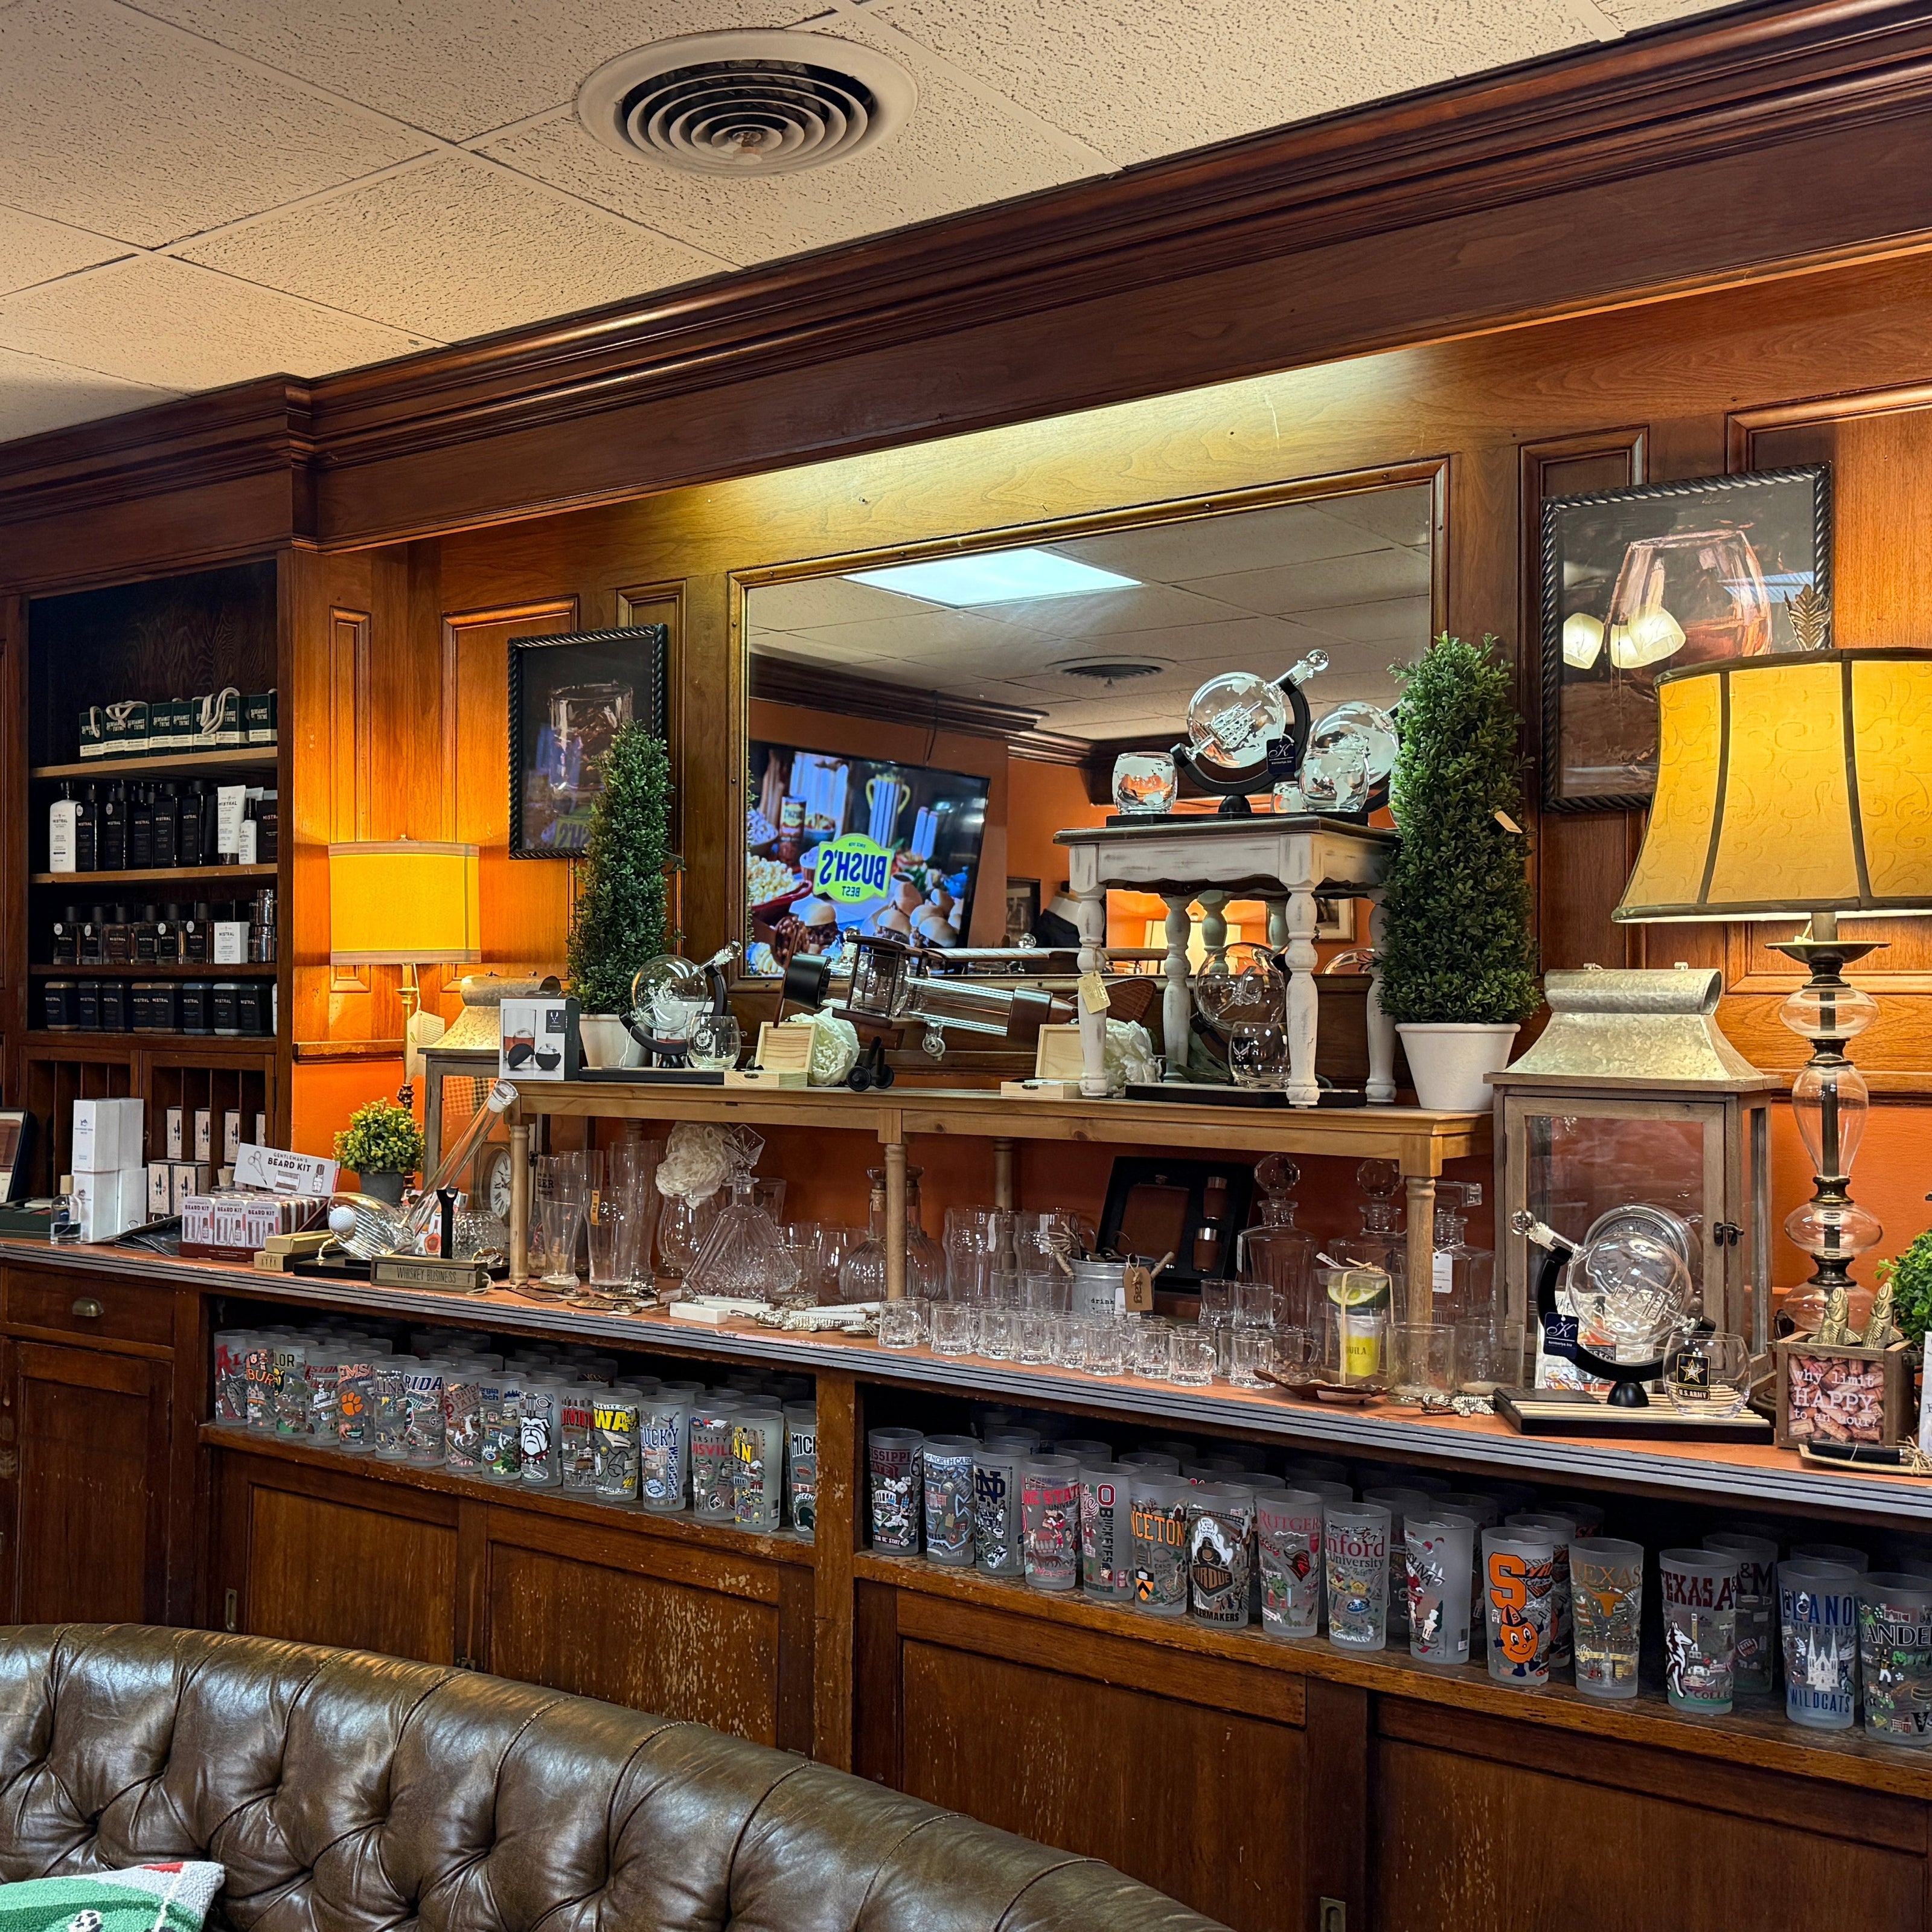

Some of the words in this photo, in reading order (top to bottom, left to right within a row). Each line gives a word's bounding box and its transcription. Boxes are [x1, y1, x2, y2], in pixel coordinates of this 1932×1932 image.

[267, 1157, 295, 1169] BEARD
[297, 1163, 312, 1172] KIT
[273, 1153, 308, 1163] GENTLEMAN'S
[397, 1267, 423, 1281] WHISKEY
[427, 1268, 456, 1284] BUSINESS
[1546, 1322, 1577, 1337] K
[1794, 1369, 1823, 1385] why
[1831, 1372, 1875, 1387] limit
[1794, 1387, 1875, 1413] HAPPY
[1794, 1409, 1808, 1419] to
[1814, 1413, 1831, 1422] an
[1839, 1413, 1878, 1429] hour?
[932, 1454, 953, 1465] NORTH
[1329, 1553, 1384, 1570] University
[1488, 1552, 1527, 1610] S
[1791, 1689, 1850, 1713] WILDCATS
